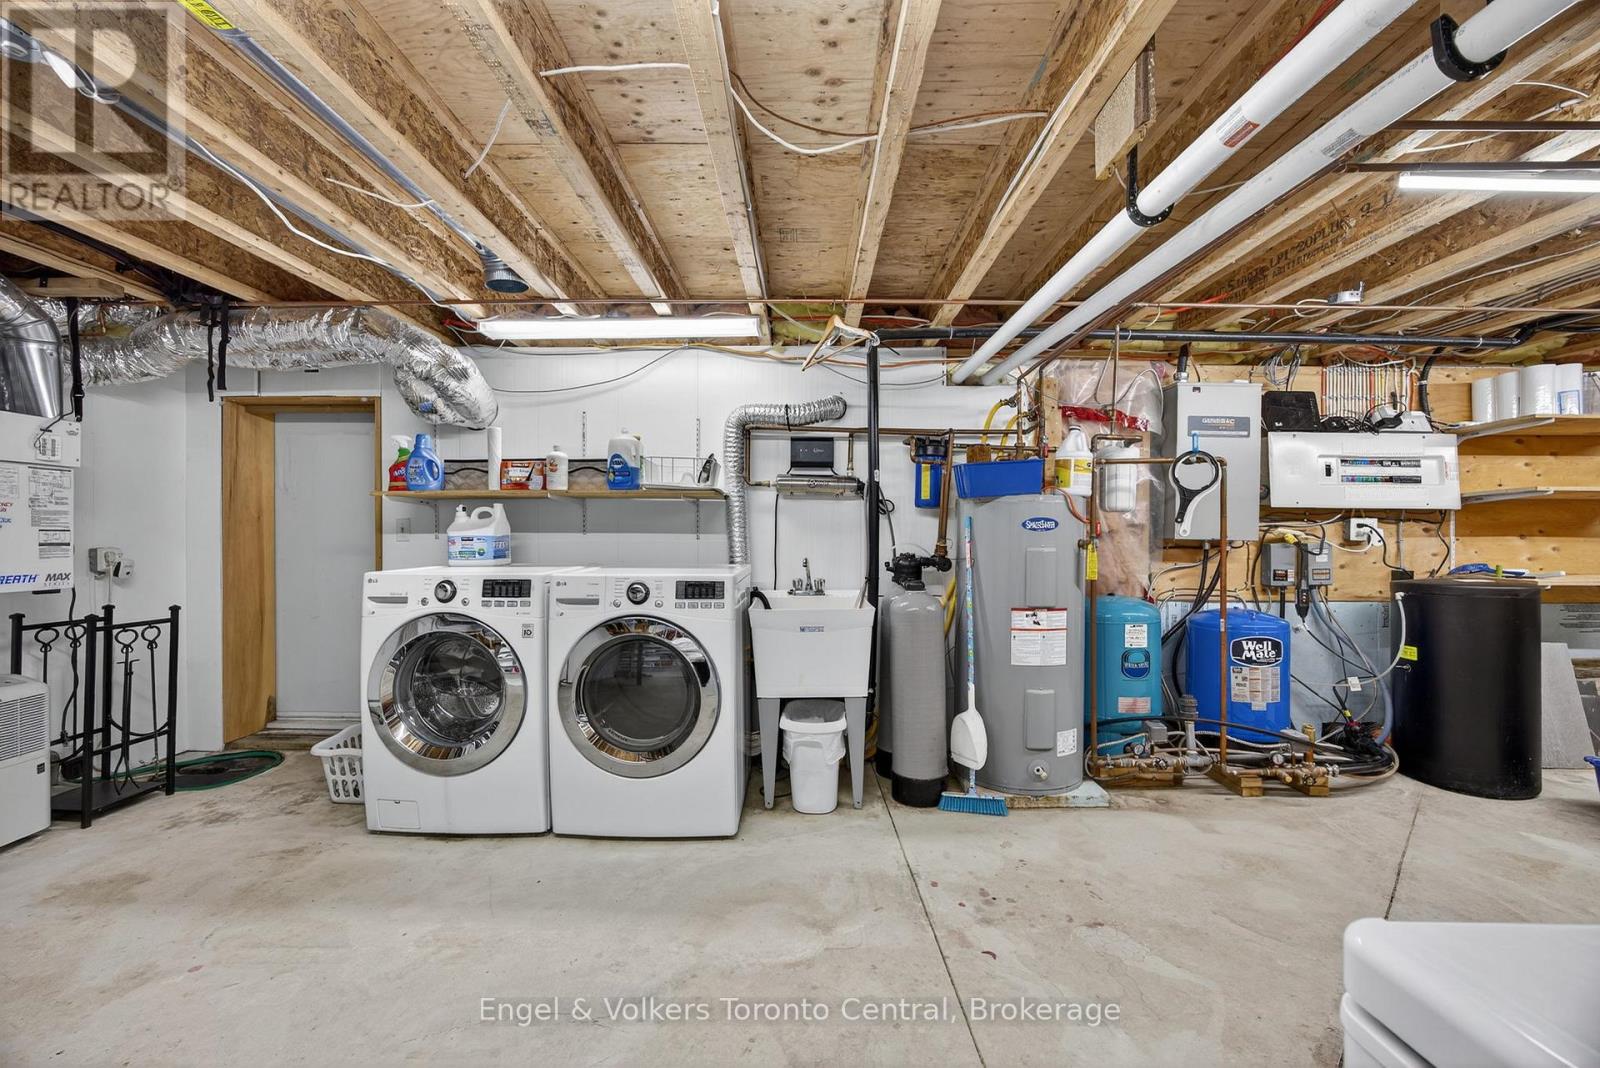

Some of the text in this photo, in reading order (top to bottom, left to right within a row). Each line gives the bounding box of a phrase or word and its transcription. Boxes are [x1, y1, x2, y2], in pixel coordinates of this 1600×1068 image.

[45, 572, 71, 583] MAX
[1241, 640, 1272, 652] Well
[1242, 650, 1276, 660] Mate
